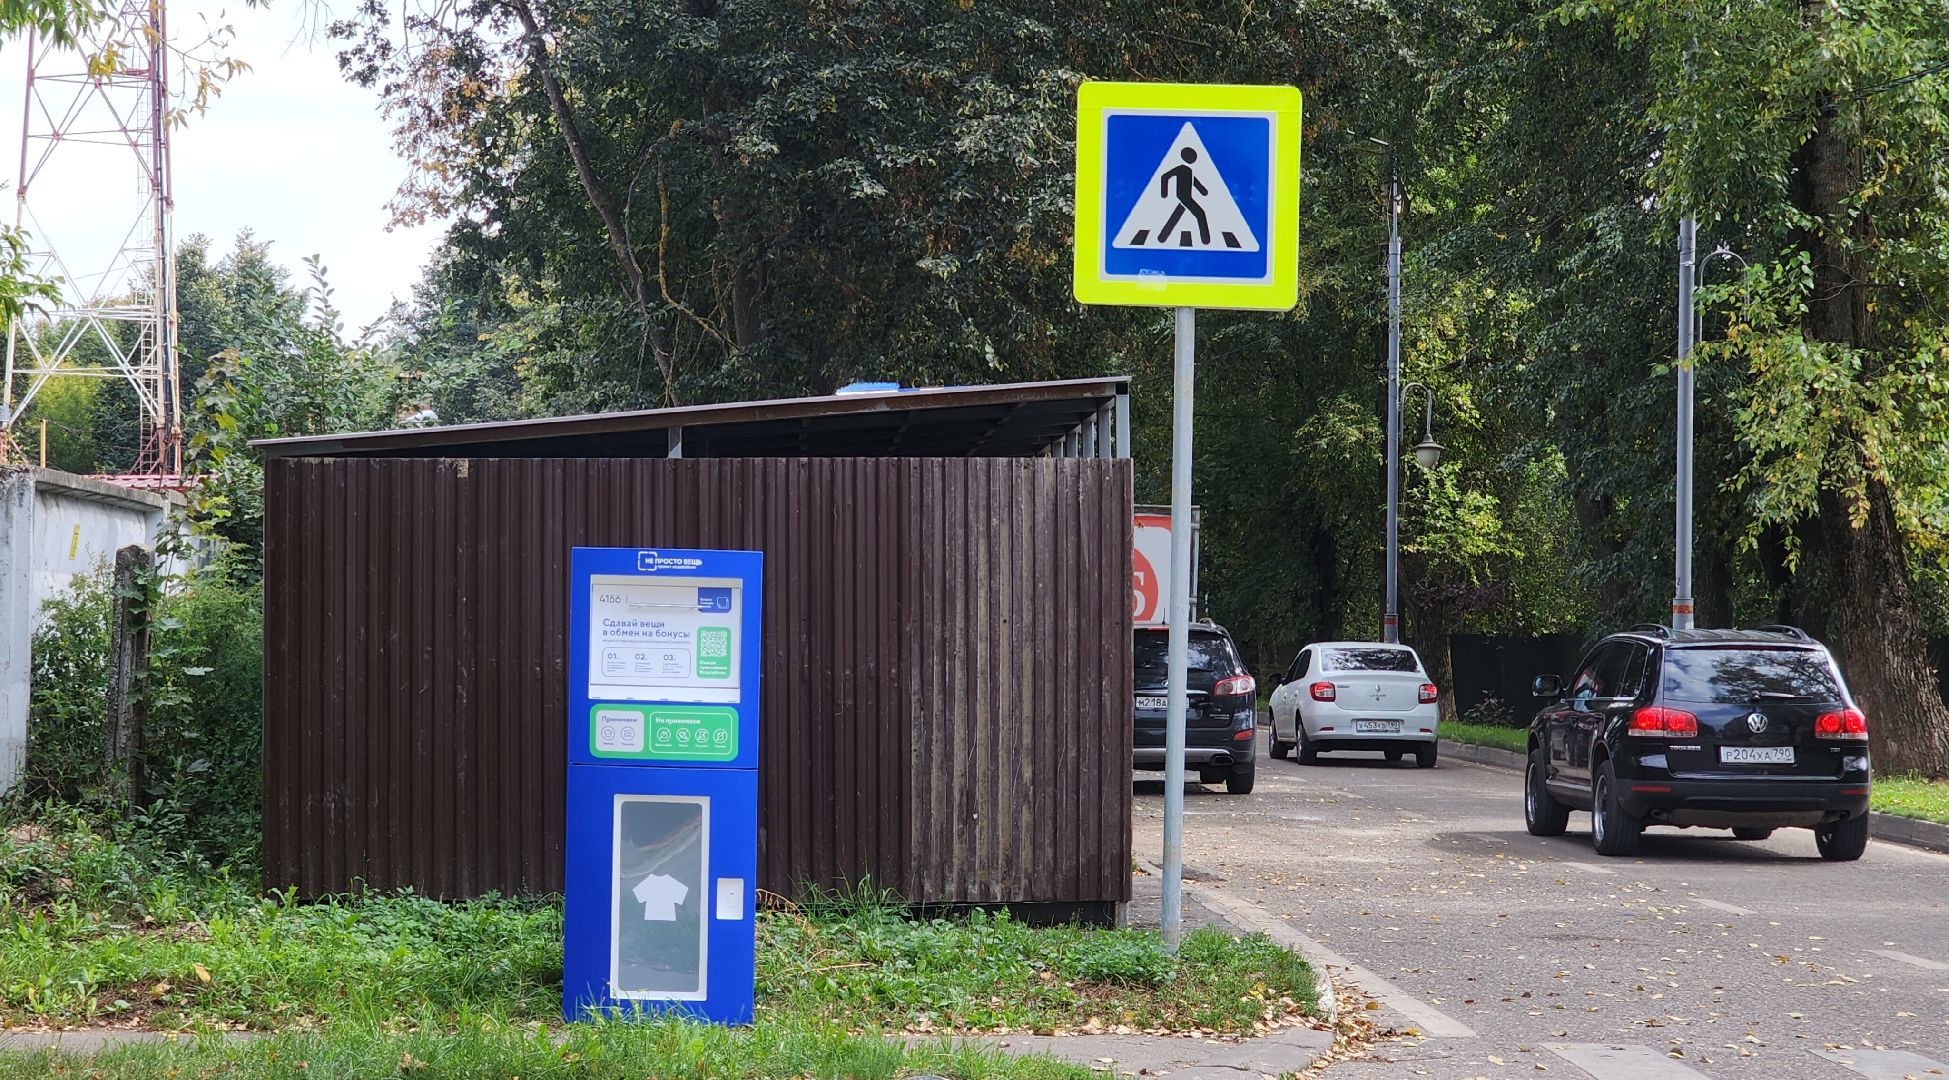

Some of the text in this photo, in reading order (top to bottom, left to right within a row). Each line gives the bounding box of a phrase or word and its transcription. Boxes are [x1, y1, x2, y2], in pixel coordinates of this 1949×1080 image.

[645, 557, 654, 565] НЕ
[683, 558, 703, 566] ВЕЩЬ
[600, 594, 621, 603] 4166
[602, 618, 665, 628] Сдавай вещи
[609, 628, 640, 637] обмен
[655, 628, 691, 639] бонусы
[607, 652, 619, 660] 01.
[1726, 748, 1792, 761] Р204ХА 790
